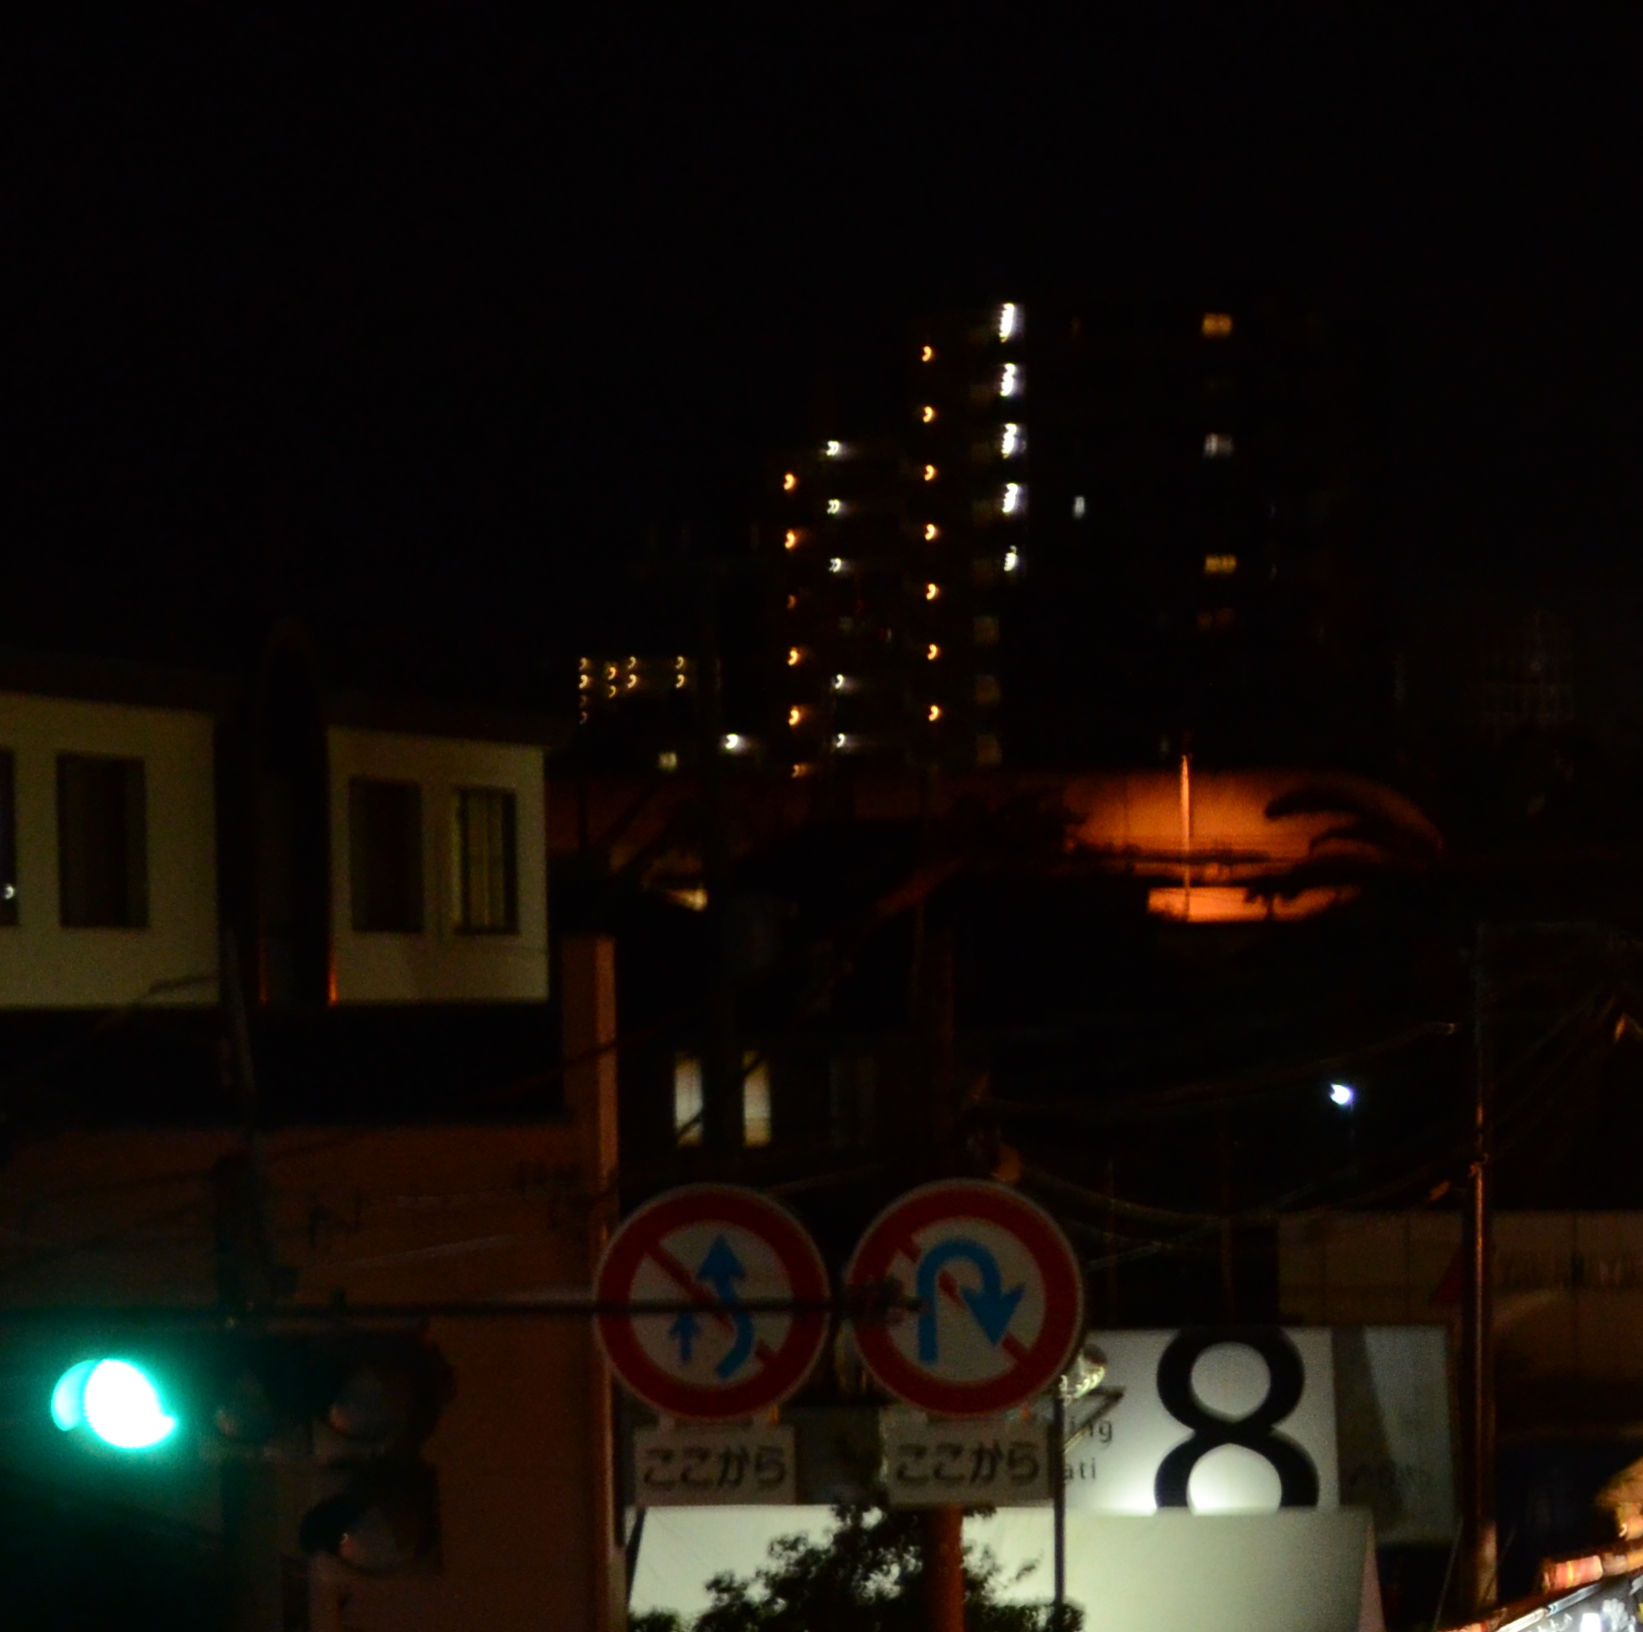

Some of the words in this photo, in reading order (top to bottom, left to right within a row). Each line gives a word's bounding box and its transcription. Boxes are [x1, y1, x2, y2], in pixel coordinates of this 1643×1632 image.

[1154, 1326, 1320, 1508] 8
[643, 1444, 787, 1489] ここから
[896, 1438, 1041, 1485] ここから
